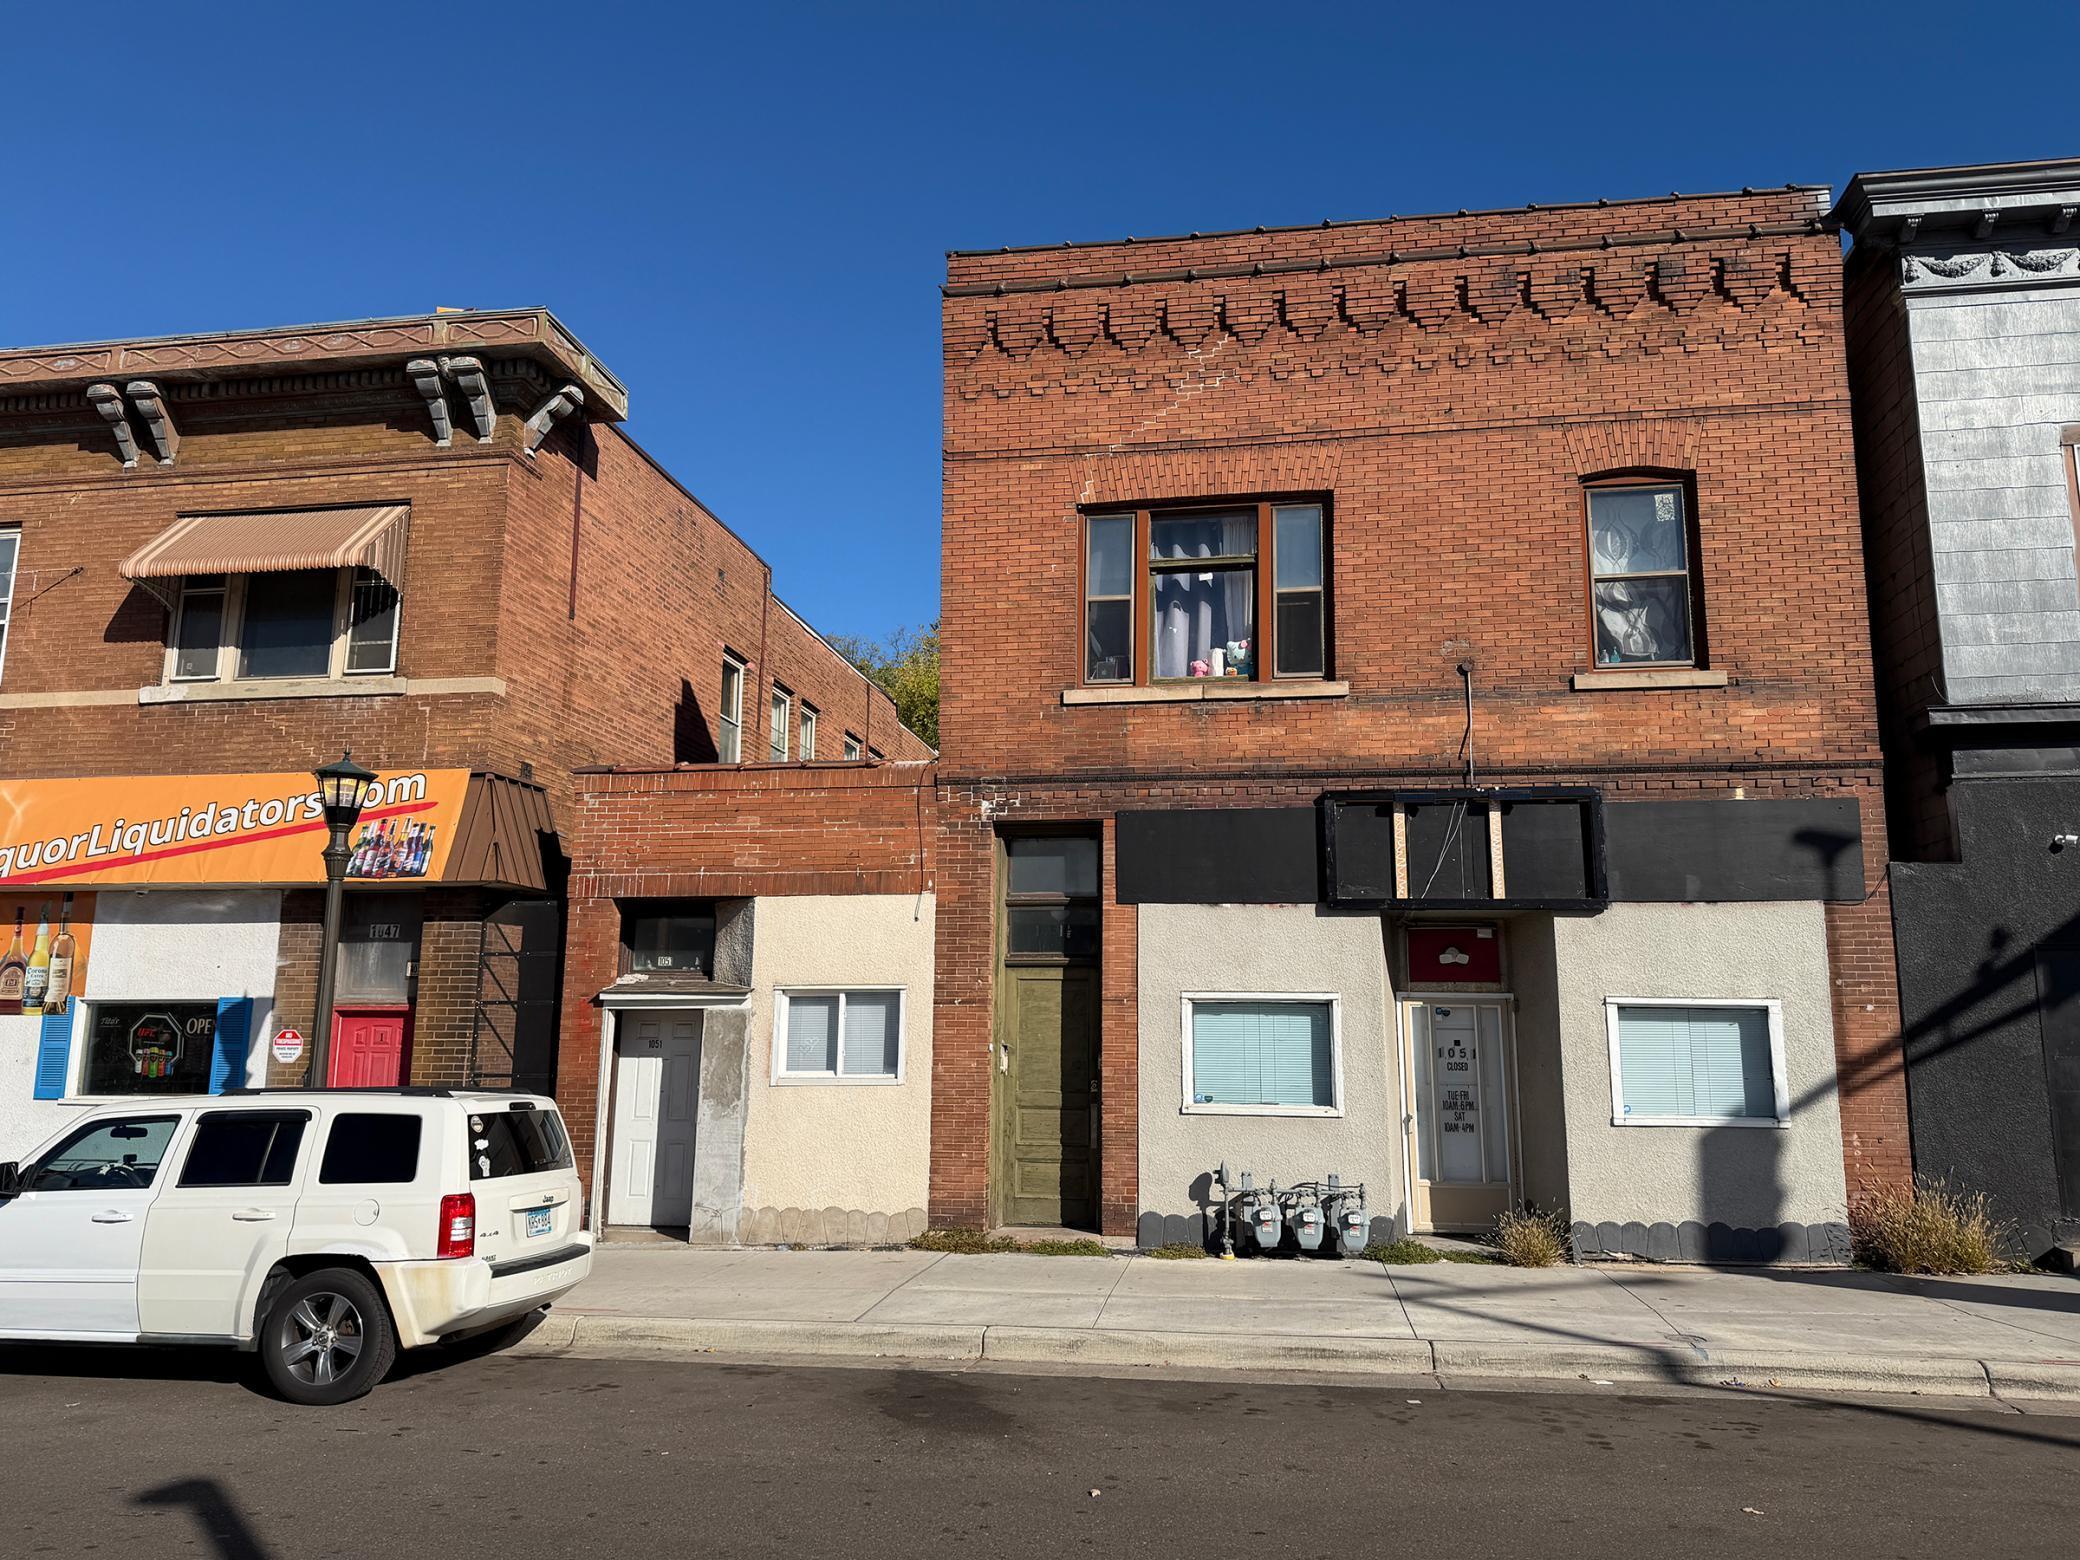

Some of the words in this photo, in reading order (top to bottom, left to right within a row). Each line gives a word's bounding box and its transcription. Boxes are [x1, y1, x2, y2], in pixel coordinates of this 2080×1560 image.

[371, 925, 399, 937] 1047
[659, 957, 673, 965] 1051
[648, 1039, 663, 1049] 1051
[1446, 1062, 1469, 1071] CLOSED
[1454, 1111, 1466, 1121] SAT
[543, 1194, 554, 1203] Jeep
